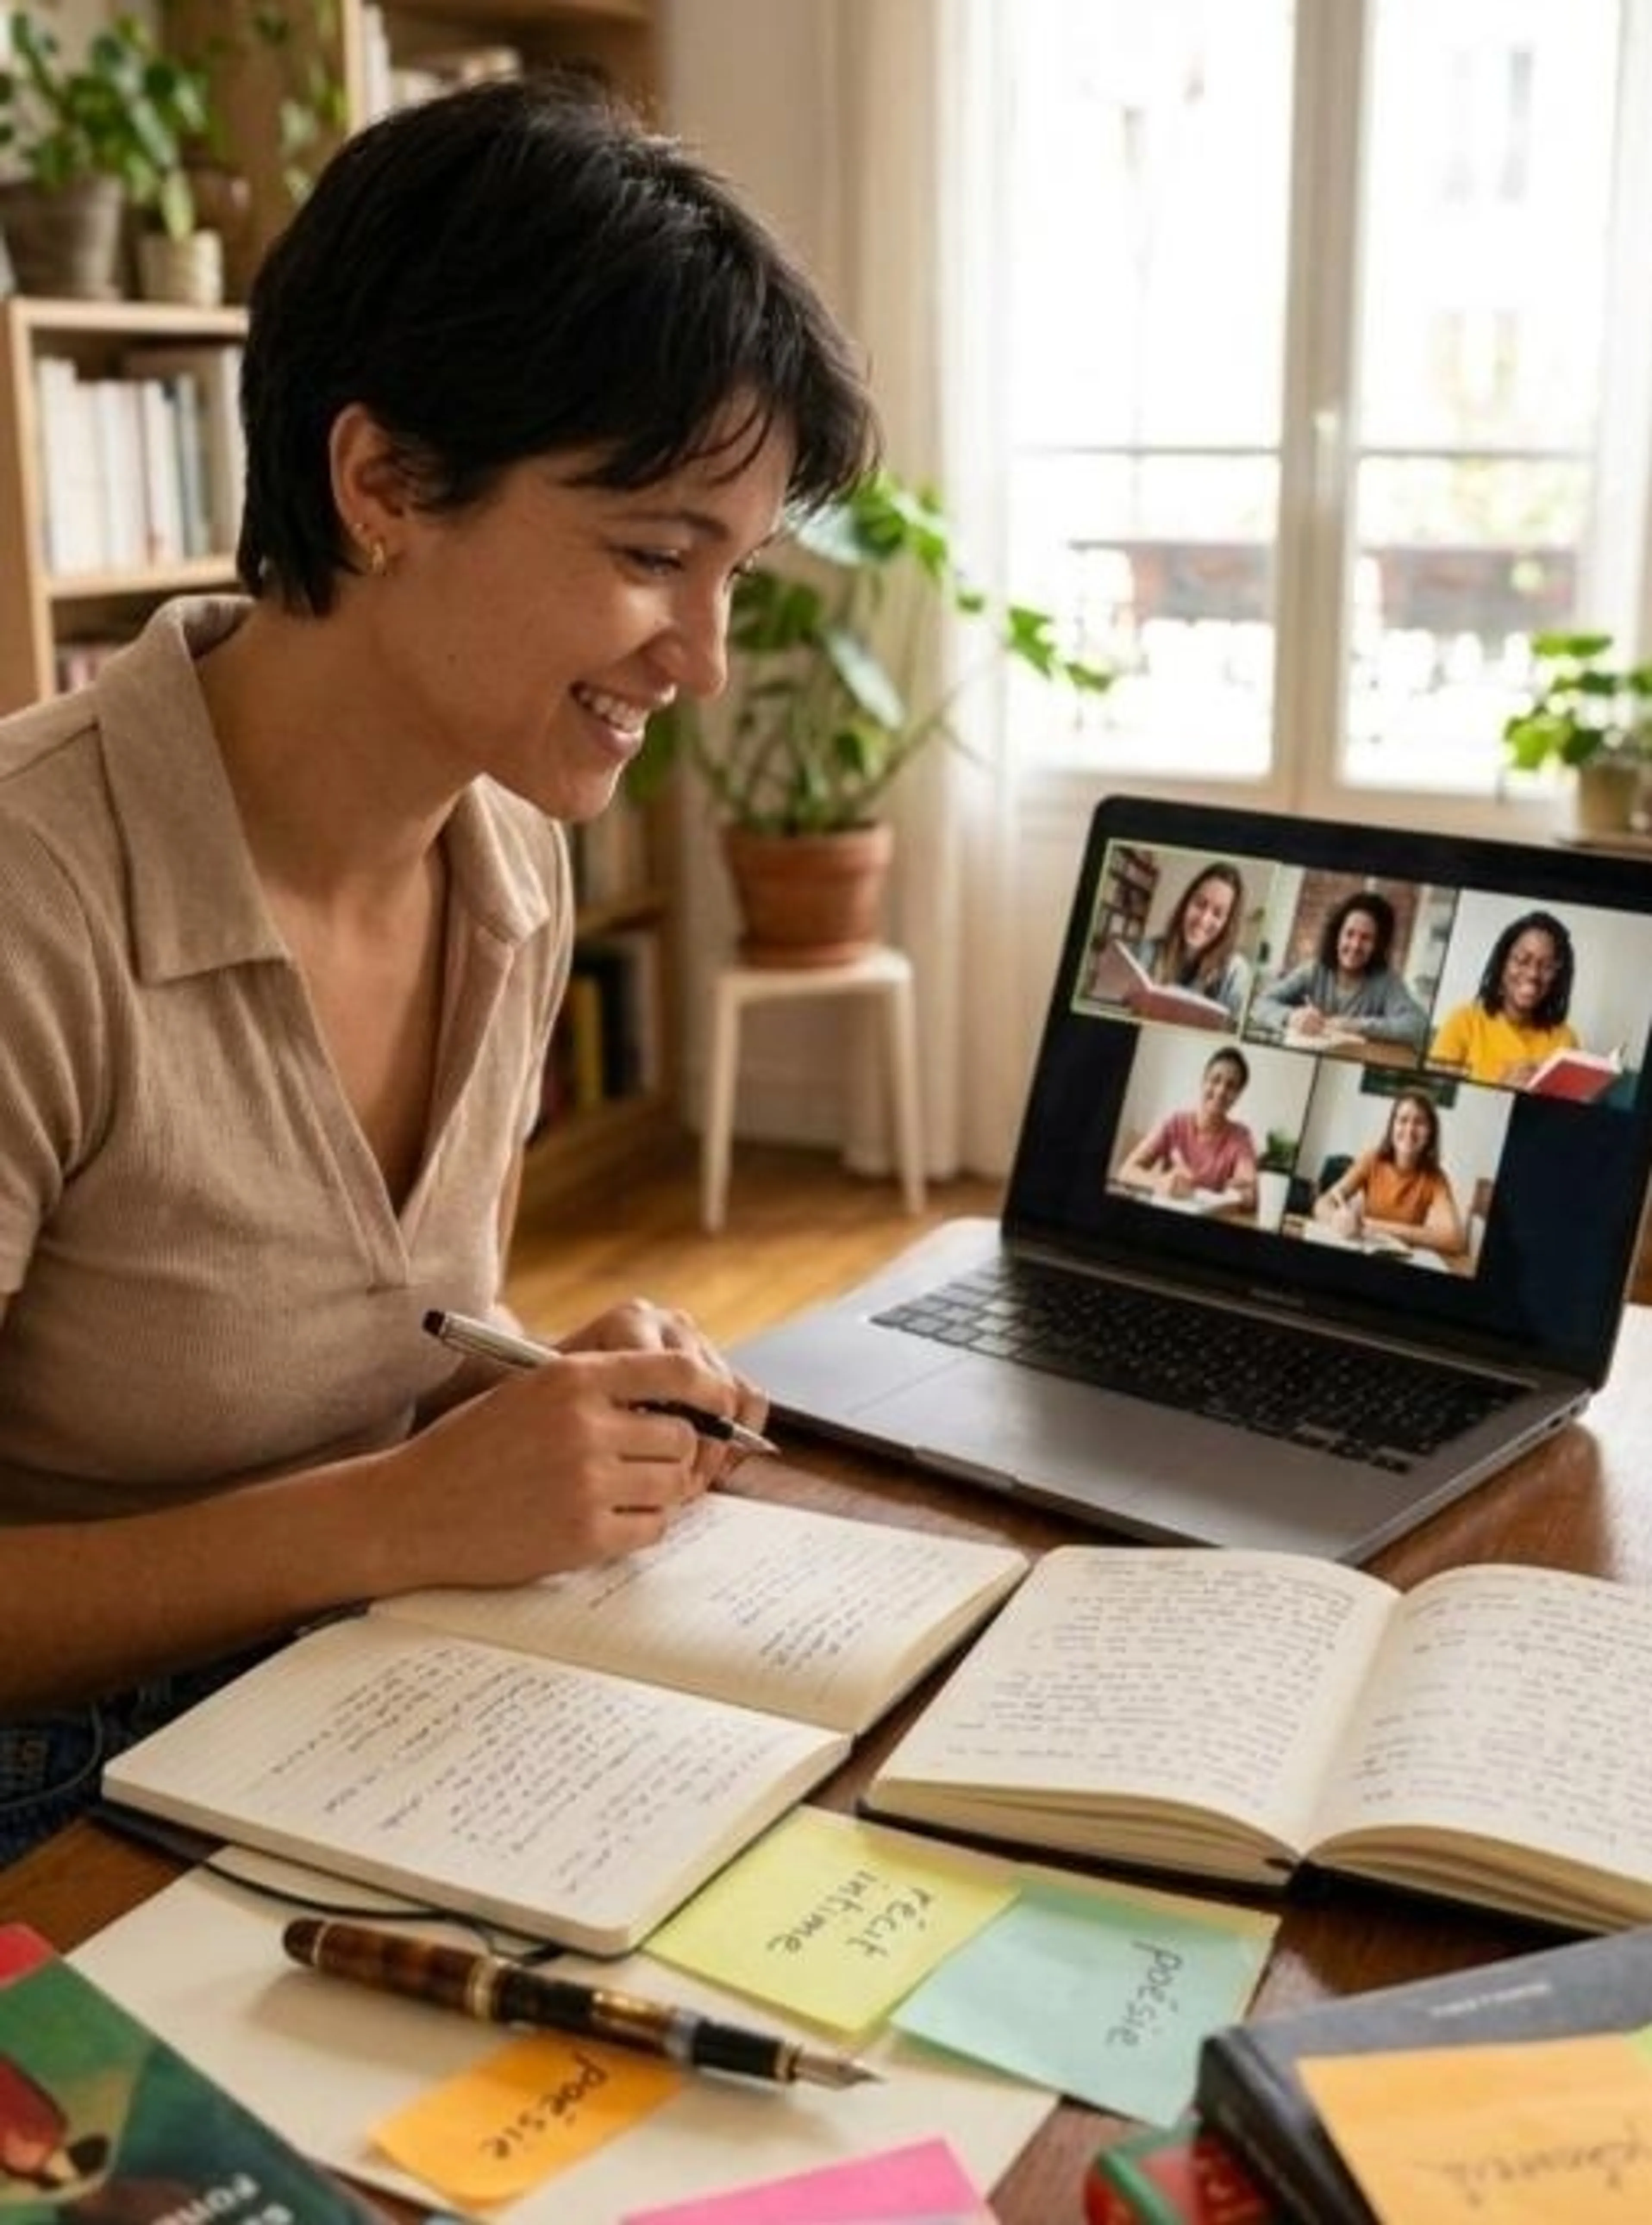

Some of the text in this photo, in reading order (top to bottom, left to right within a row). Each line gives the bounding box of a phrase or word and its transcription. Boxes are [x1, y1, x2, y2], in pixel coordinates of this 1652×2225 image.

[766, 1870, 889, 1952] intime
[845, 1887, 930, 1958] récit
[1104, 1940, 1183, 2047] poésie
[477, 2050, 609, 2159] poésie
